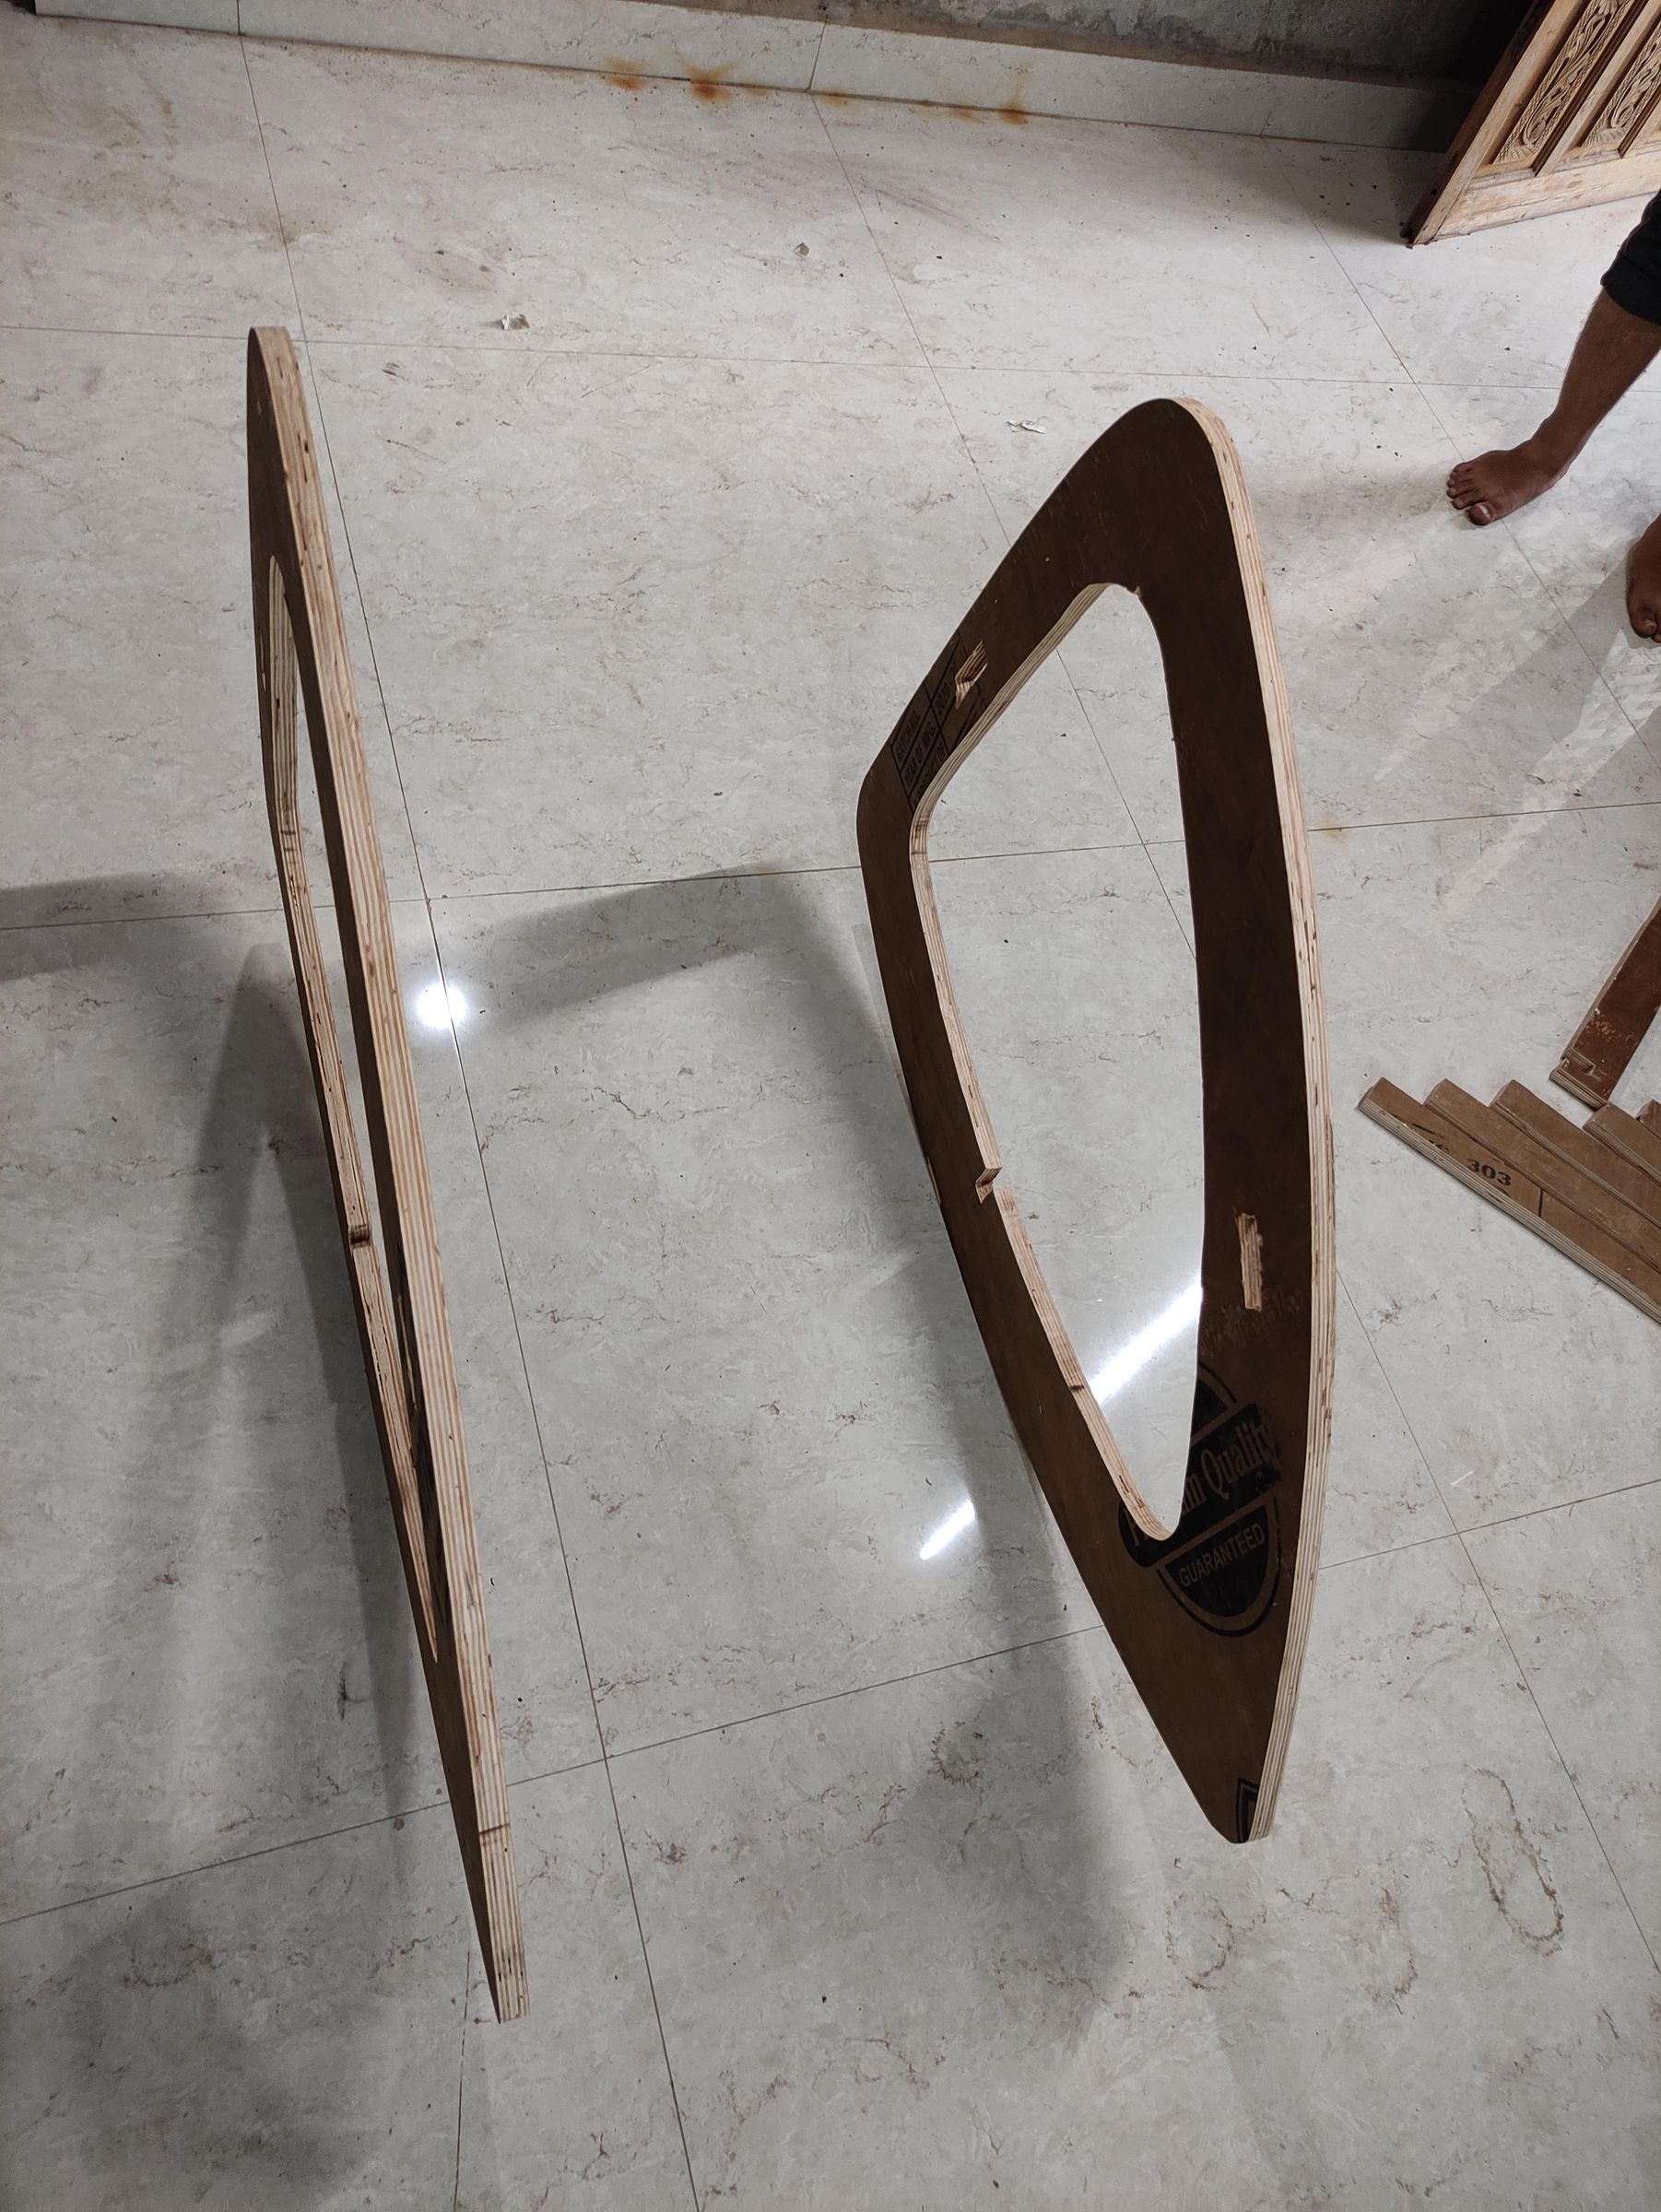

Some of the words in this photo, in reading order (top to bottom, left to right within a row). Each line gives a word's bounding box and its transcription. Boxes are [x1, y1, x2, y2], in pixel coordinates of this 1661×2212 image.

[1467, 1158, 1512, 1186] 303
[1200, 1421, 1279, 1500] Quality
[1179, 1523, 1266, 1587] GUARANTEED
